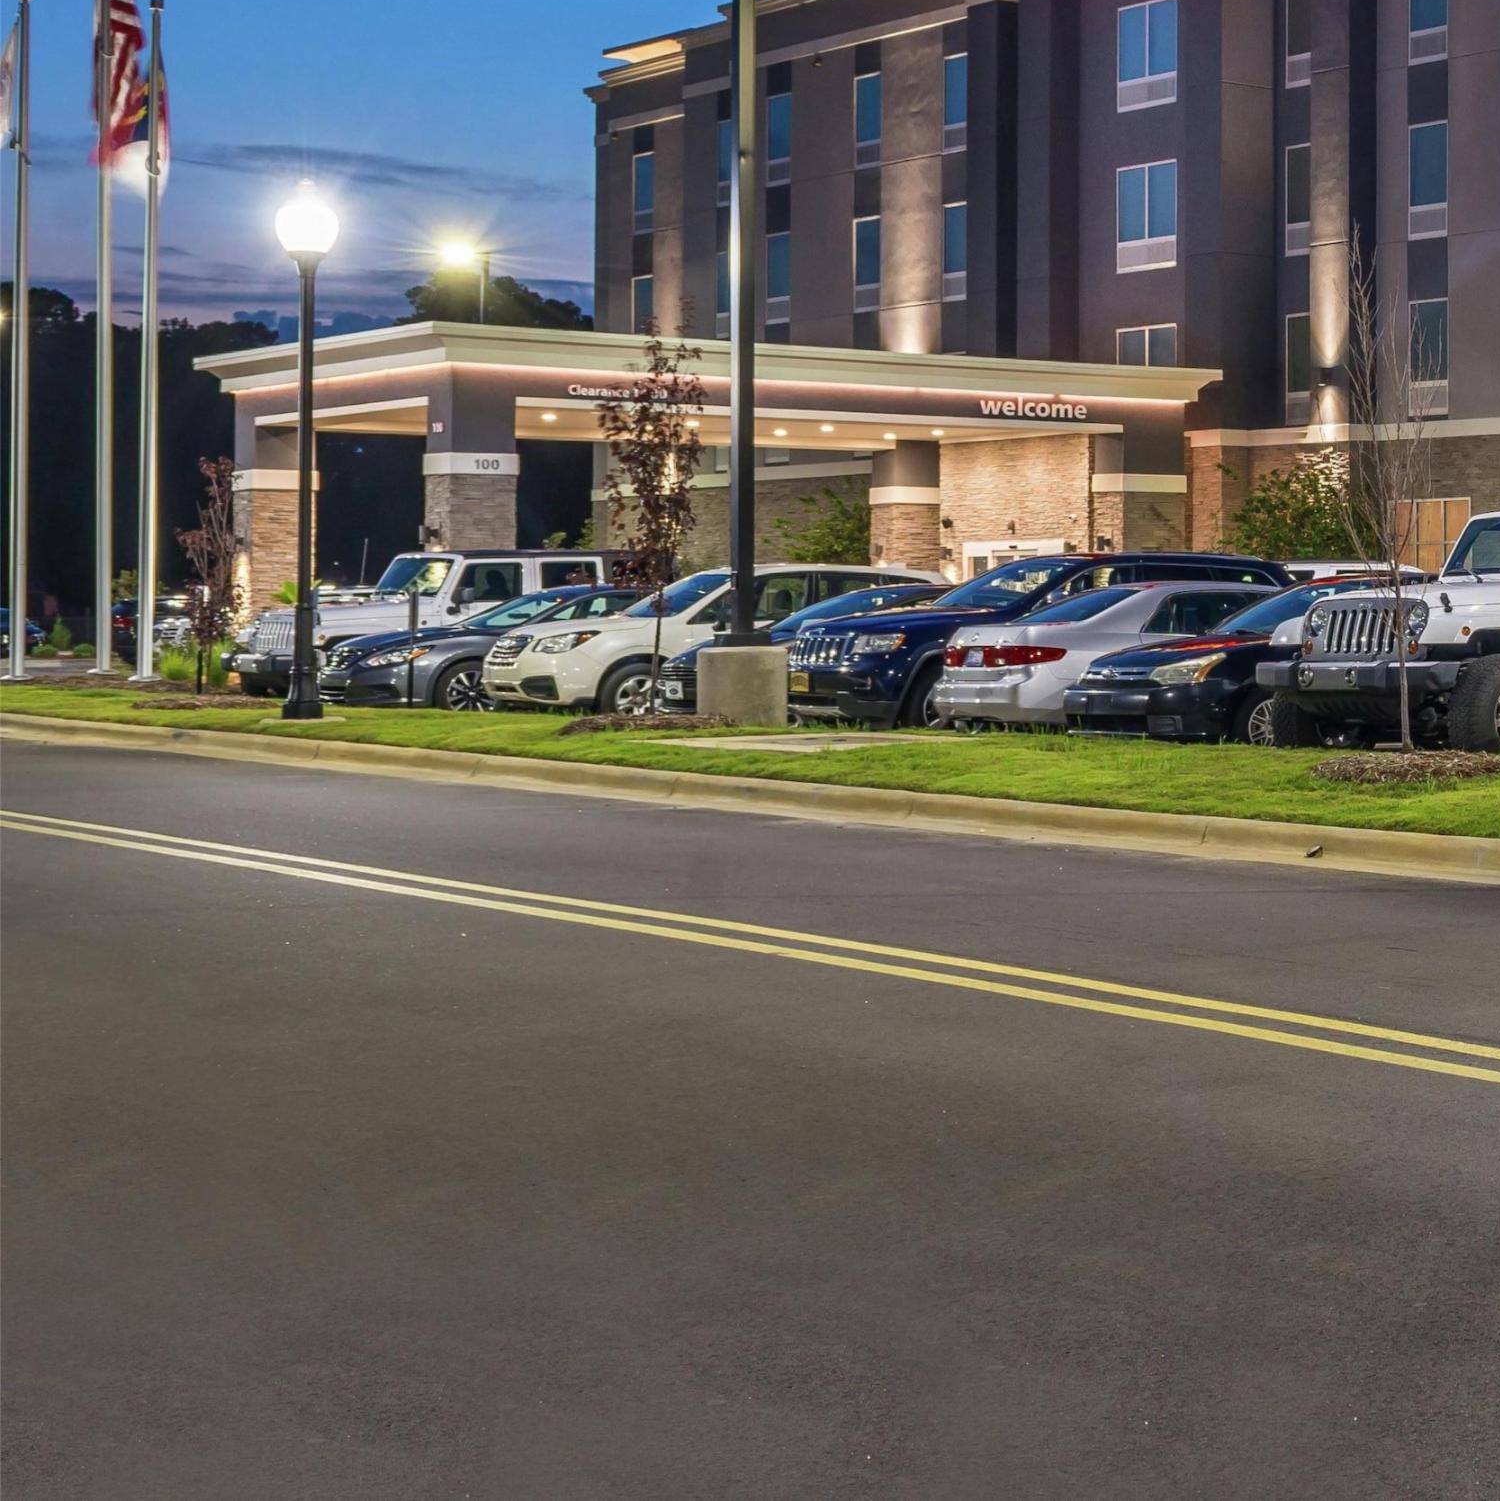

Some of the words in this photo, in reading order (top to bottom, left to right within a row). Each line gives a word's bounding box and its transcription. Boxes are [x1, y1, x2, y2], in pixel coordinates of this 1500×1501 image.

[568, 384, 630, 398] Clearance
[980, 394, 1088, 419] welcome
[474, 459, 500, 471] 100
